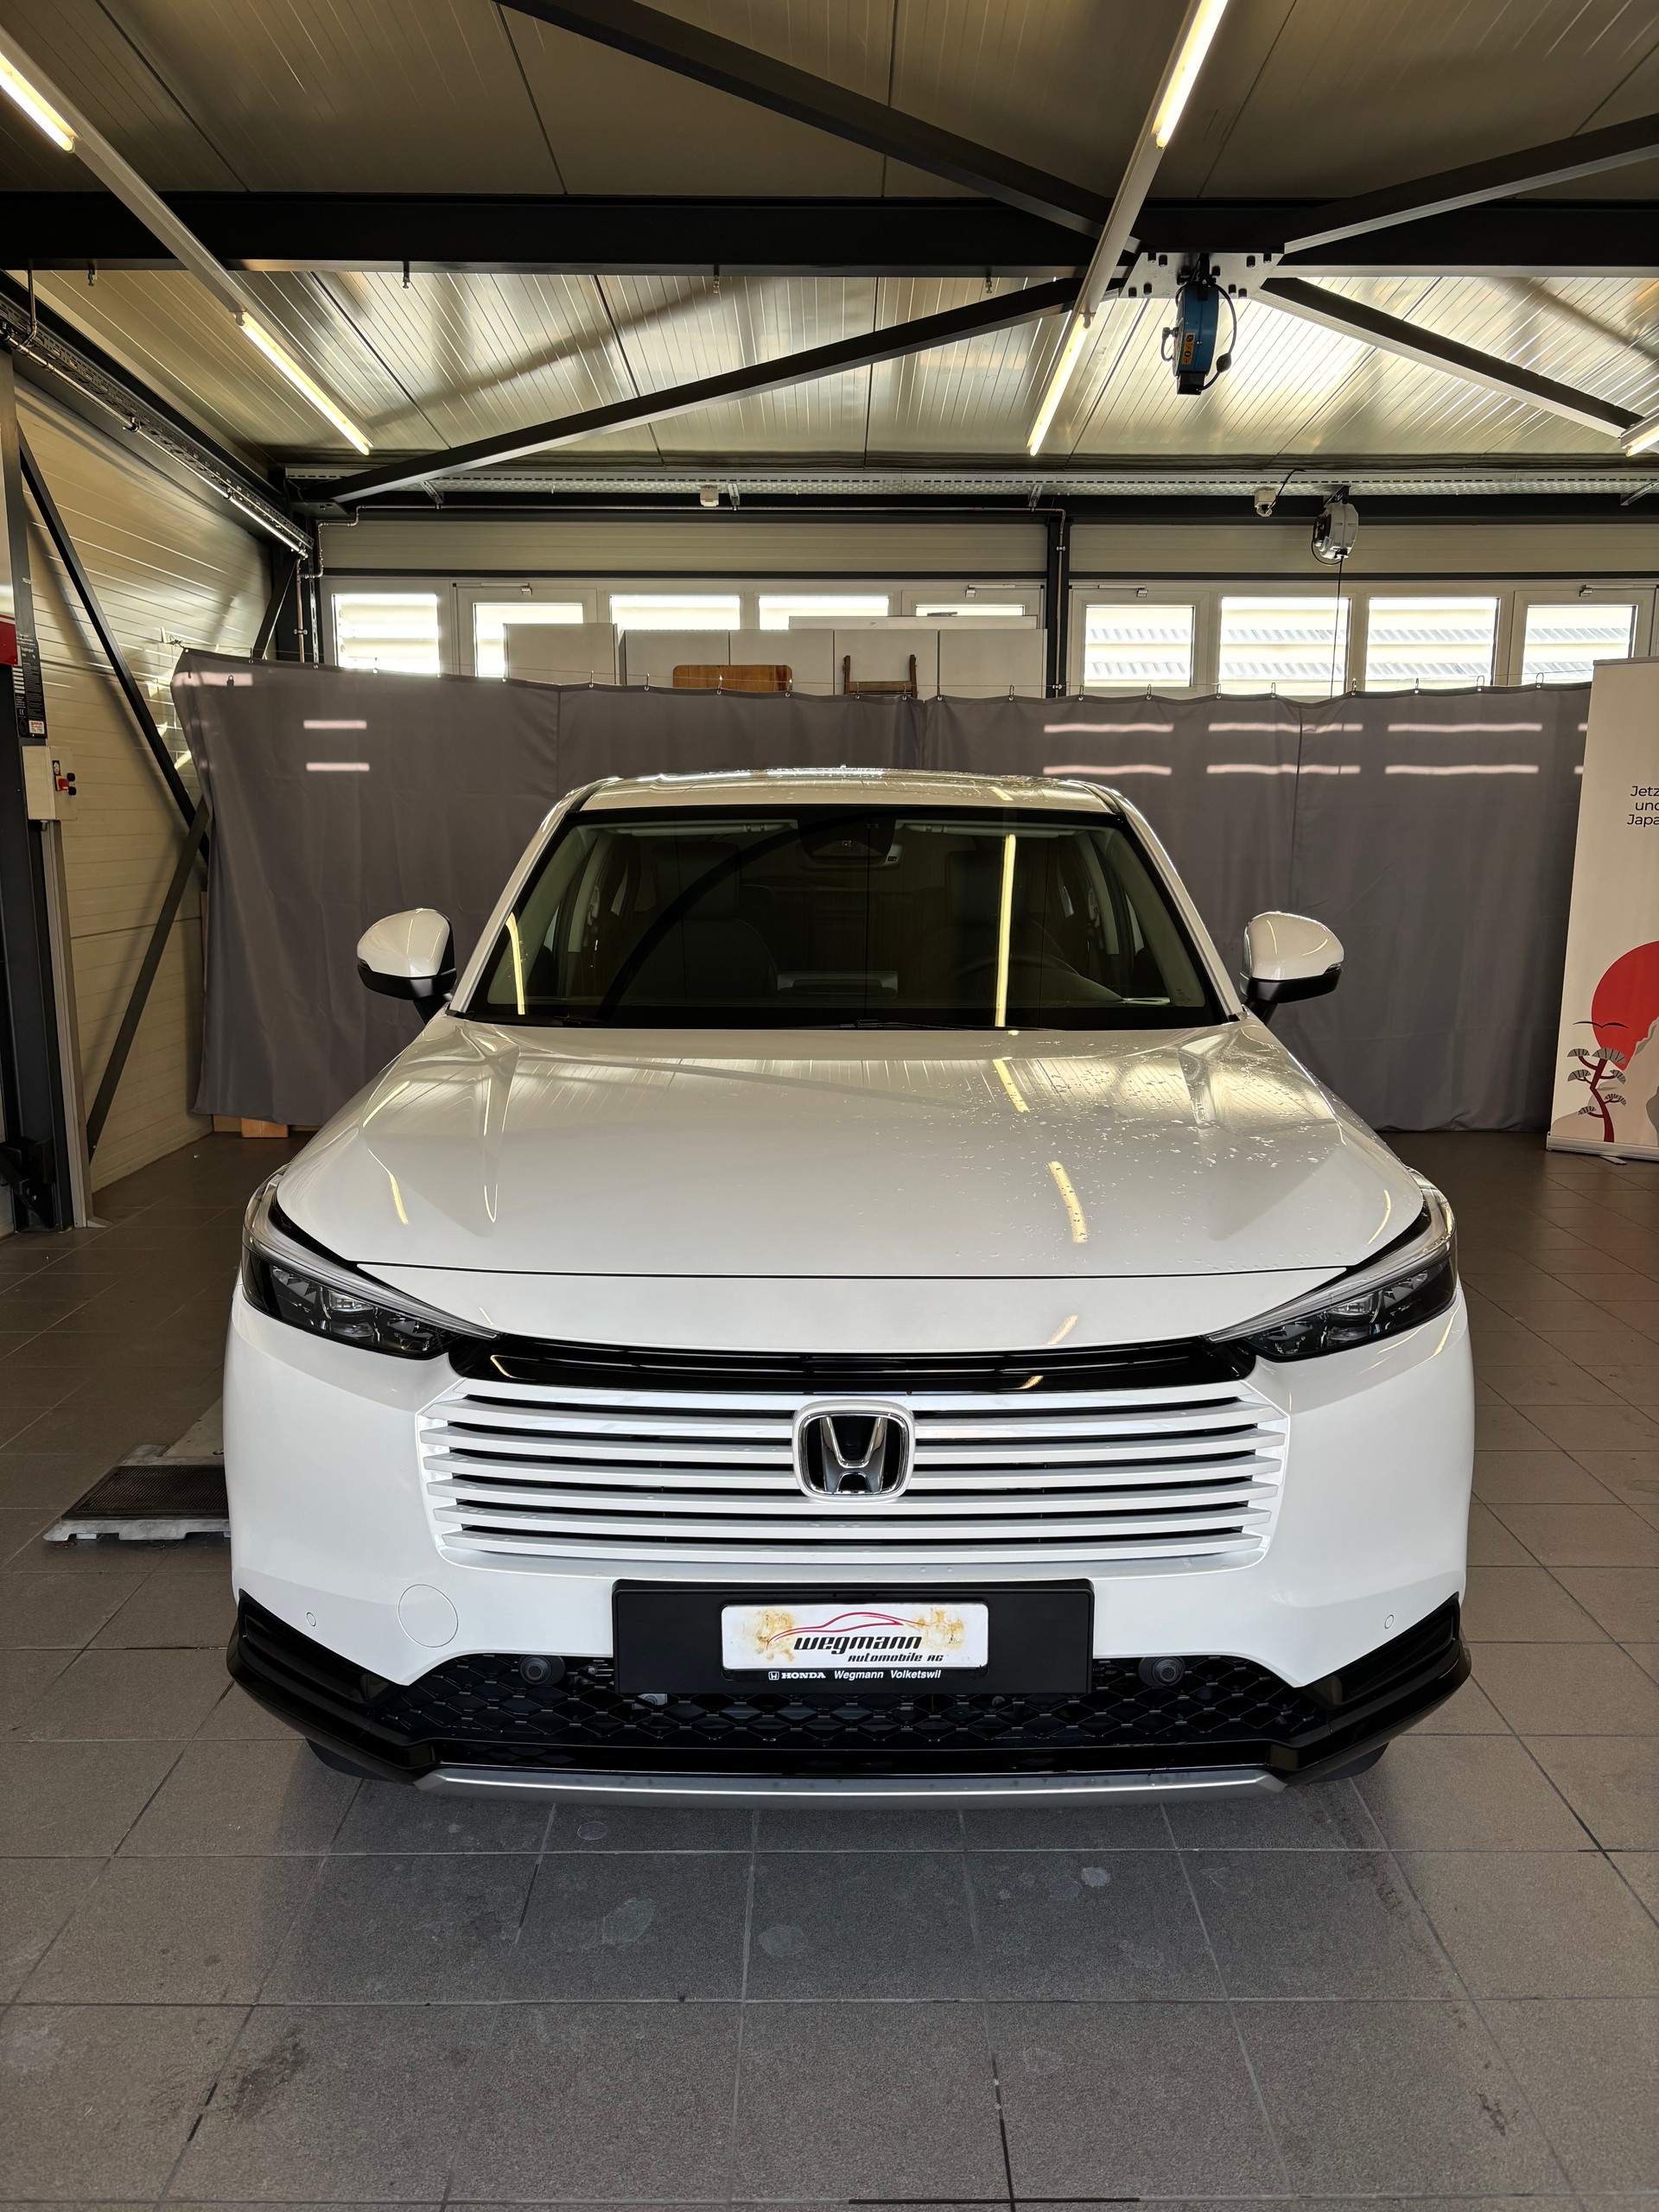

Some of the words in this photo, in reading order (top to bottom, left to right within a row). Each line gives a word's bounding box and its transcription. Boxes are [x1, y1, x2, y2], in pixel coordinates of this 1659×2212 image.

[793, 1637, 922, 1655] wegmann
[781, 1671, 826, 1680] HONDA
[834, 1669, 884, 1681] Wegmann
[890, 1669, 942, 1679] Volketswil
